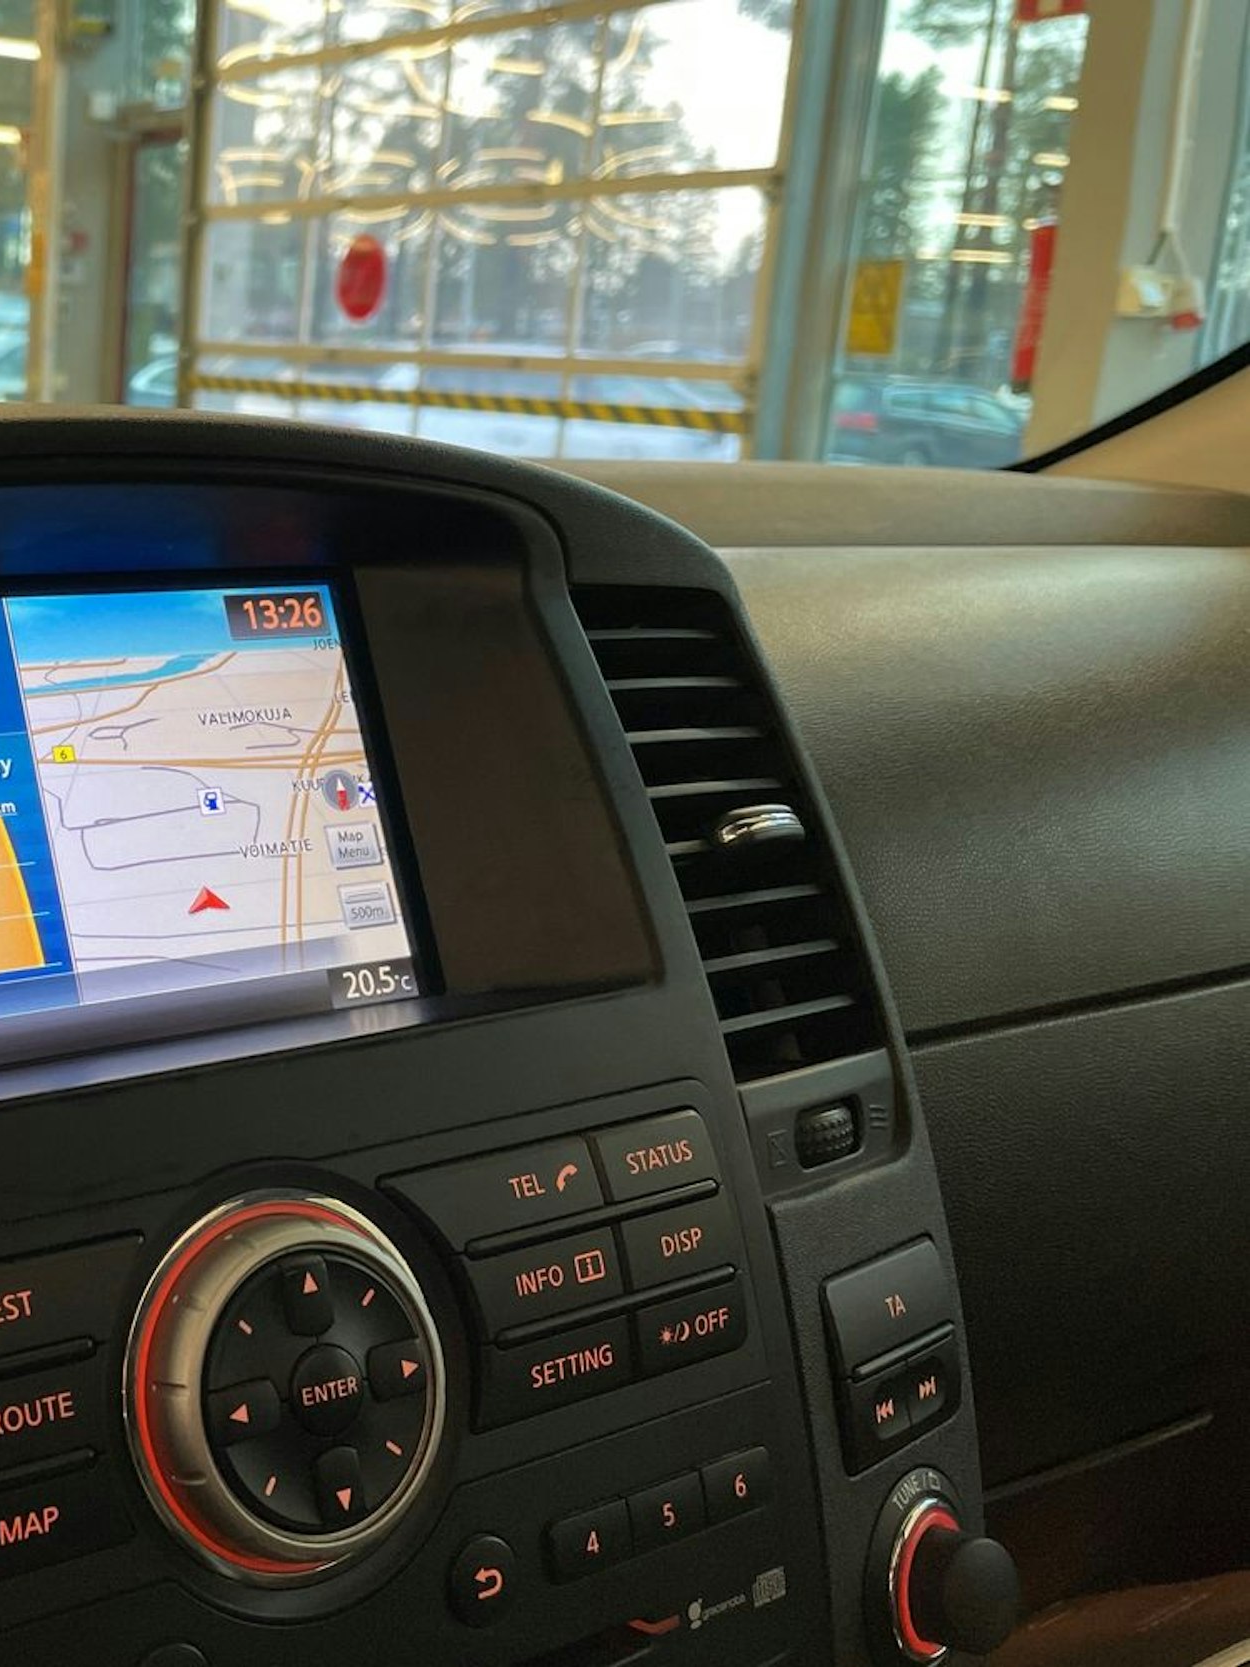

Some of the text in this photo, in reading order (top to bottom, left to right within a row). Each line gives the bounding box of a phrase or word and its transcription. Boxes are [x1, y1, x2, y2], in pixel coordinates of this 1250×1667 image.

[243, 597, 323, 631] 13:26
[197, 707, 293, 728] VALIMOKUJA
[59, 748, 68, 761] 6
[239, 838, 314, 859] VOIMATIE
[337, 831, 364, 845] Map
[337, 846, 370, 859] Menu
[350, 905, 384, 920] 500m
[625, 1140, 693, 1175] STATUS
[508, 1173, 546, 1199] TEL
[660, 1227, 702, 1257] DISP
[515, 1264, 564, 1297] INFO
[884, 1292, 907, 1319] TA
[694, 1307, 731, 1336] OFF
[530, 1344, 614, 1389] SETTING
[301, 1375, 359, 1407] ENTER
[733, 1472, 748, 1498] 6
[661, 1502, 677, 1527] 5
[585, 1530, 600, 1554] 4
